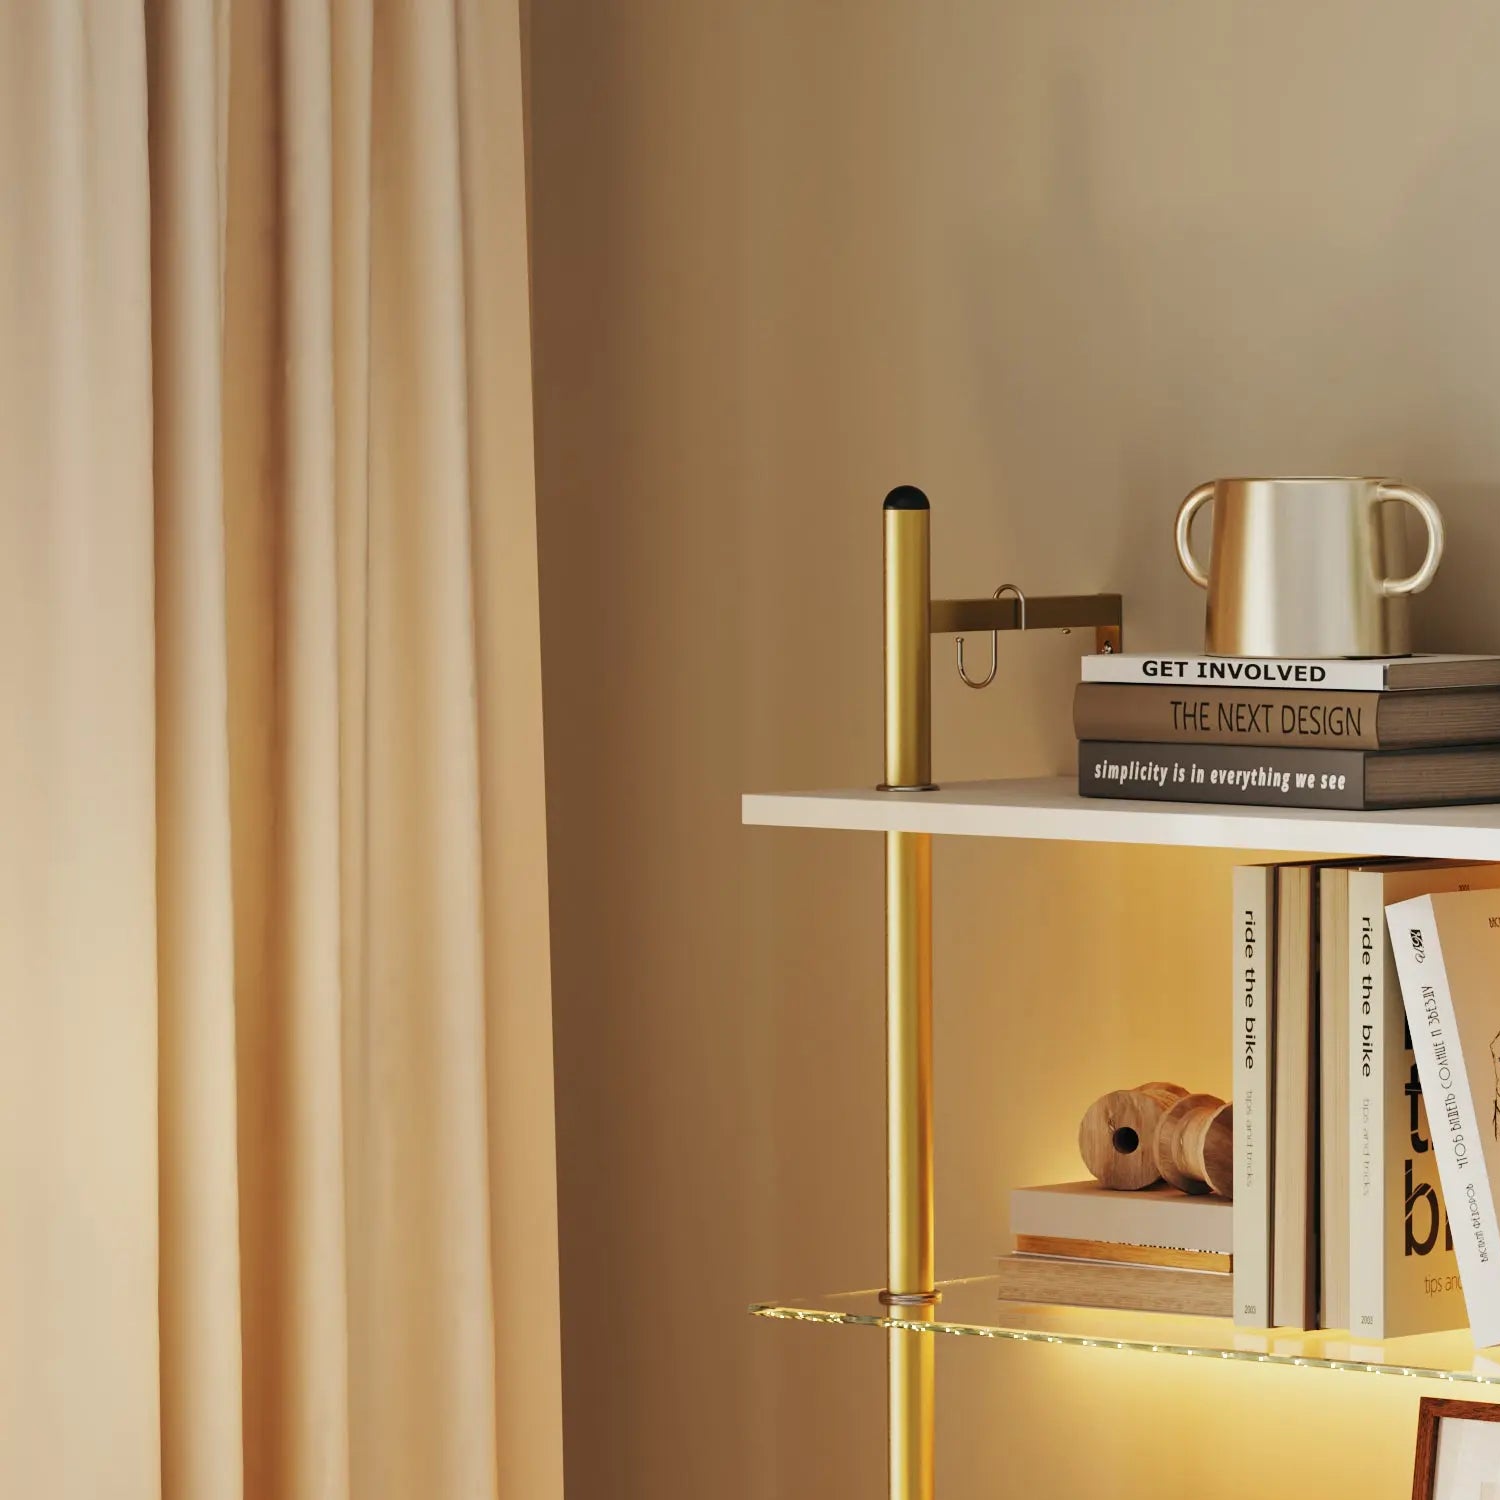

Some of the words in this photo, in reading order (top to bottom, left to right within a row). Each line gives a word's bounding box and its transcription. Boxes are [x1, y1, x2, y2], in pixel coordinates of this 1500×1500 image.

[1142, 660, 1188, 678] GET
[1197, 662, 1326, 682] INVOLVED
[1170, 701, 1209, 732] THE
[1218, 703, 1273, 734] NEXT
[1282, 704, 1362, 737] DESIGN
[1094, 760, 1168, 785] simplicity
[1173, 763, 1185, 782] is
[1191, 763, 1204, 783] in
[1210, 766, 1290, 792] everything
[1295, 771, 1317, 788] we
[1321, 772, 1346, 790] see
[1245, 910, 1255, 958] ride
[1362, 916, 1373, 965] ride
[1245, 968, 1255, 1007] the
[1362, 974, 1373, 1016] the
[1245, 1018, 1256, 1070] bike
[1362, 1025, 1373, 1078] bike
[1424, 1273, 1443, 1298] tips
